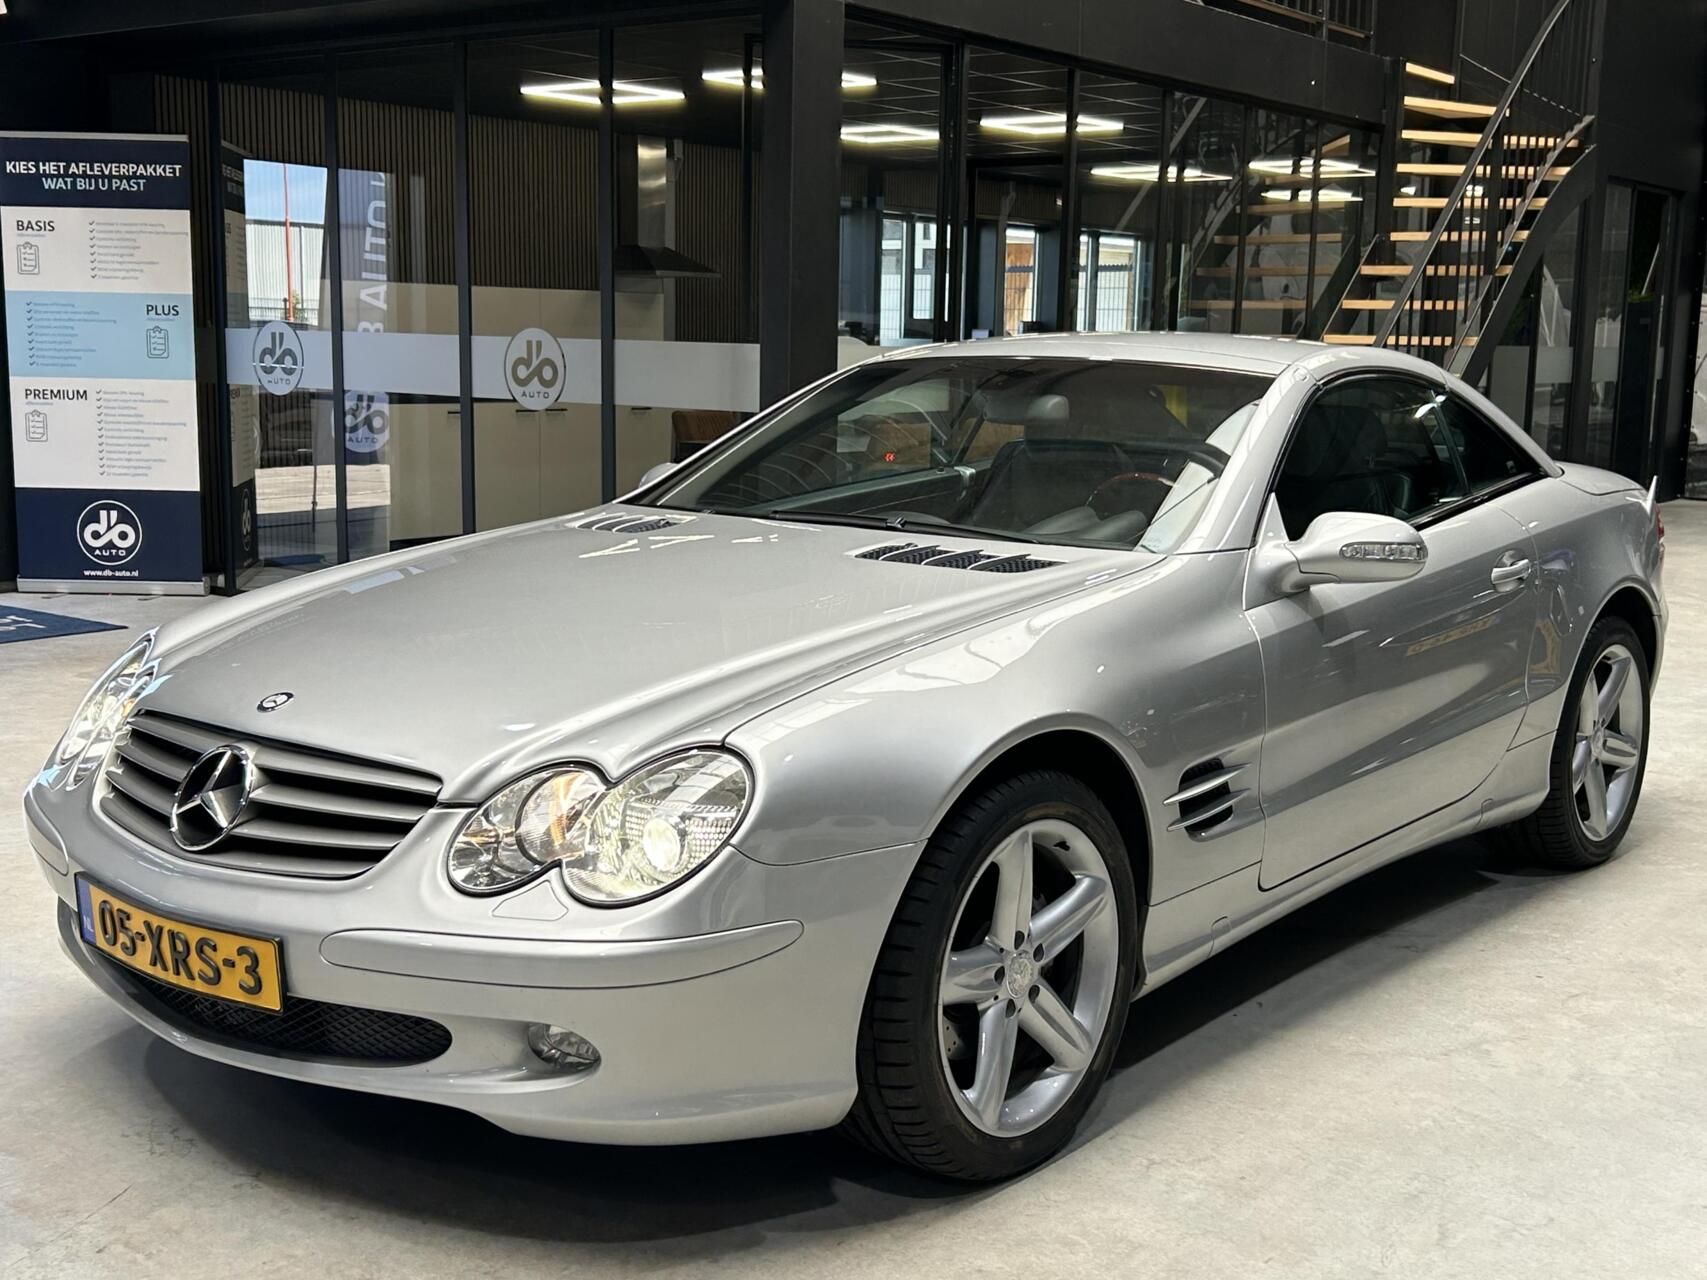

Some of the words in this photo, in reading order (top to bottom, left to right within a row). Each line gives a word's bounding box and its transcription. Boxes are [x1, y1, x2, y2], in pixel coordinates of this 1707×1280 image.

[5, 161, 37, 174] KIES
[39, 161, 66, 175] HET
[68, 162, 182, 177] AFLEVERPAKKET
[42, 177, 74, 190] WAT
[76, 178, 96, 190] BIJ
[98, 178, 109, 191] U
[112, 179, 146, 191] PAST
[16, 219, 56, 232] BASIS
[146, 304, 180, 316] PLUS
[267, 377, 291, 385] AUTO
[24, 388, 88, 401] PREMIUM
[521, 391, 550, 399] AUTO
[348, 436, 378, 444] AUTO
[94, 548, 127, 556] AUTO
[83, 568, 139, 577] www.db-auto.nl
[98, 899, 263, 996] 05-XRS-3
